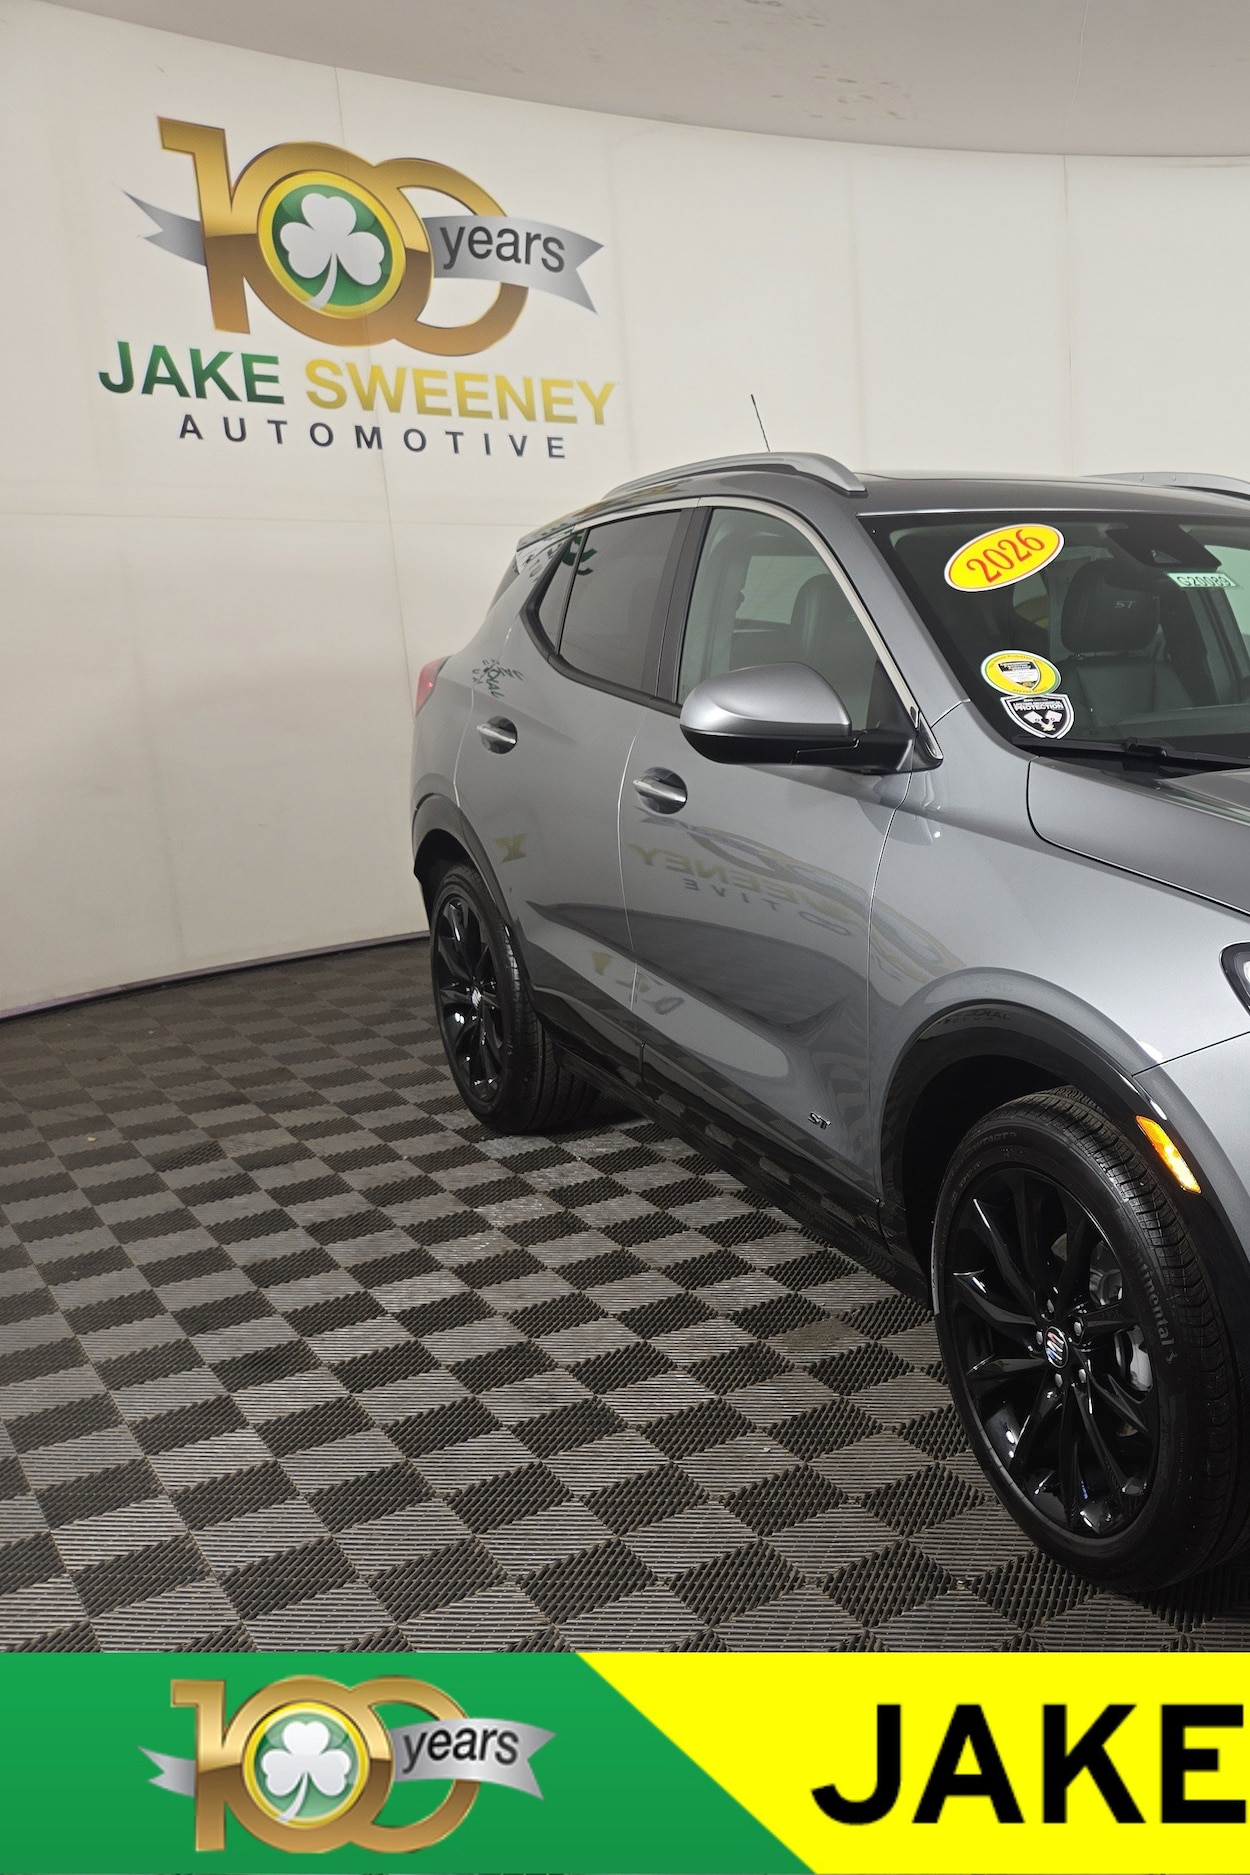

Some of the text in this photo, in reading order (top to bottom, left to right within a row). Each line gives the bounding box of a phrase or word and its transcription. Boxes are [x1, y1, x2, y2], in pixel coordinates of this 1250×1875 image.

[440, 221, 566, 273] years
[98, 341, 617, 427] JAKE SWEENEY
[179, 414, 566, 460] AUTOMOTIVE
[966, 529, 1046, 584] 2026
[807, 1111, 832, 1130] ST
